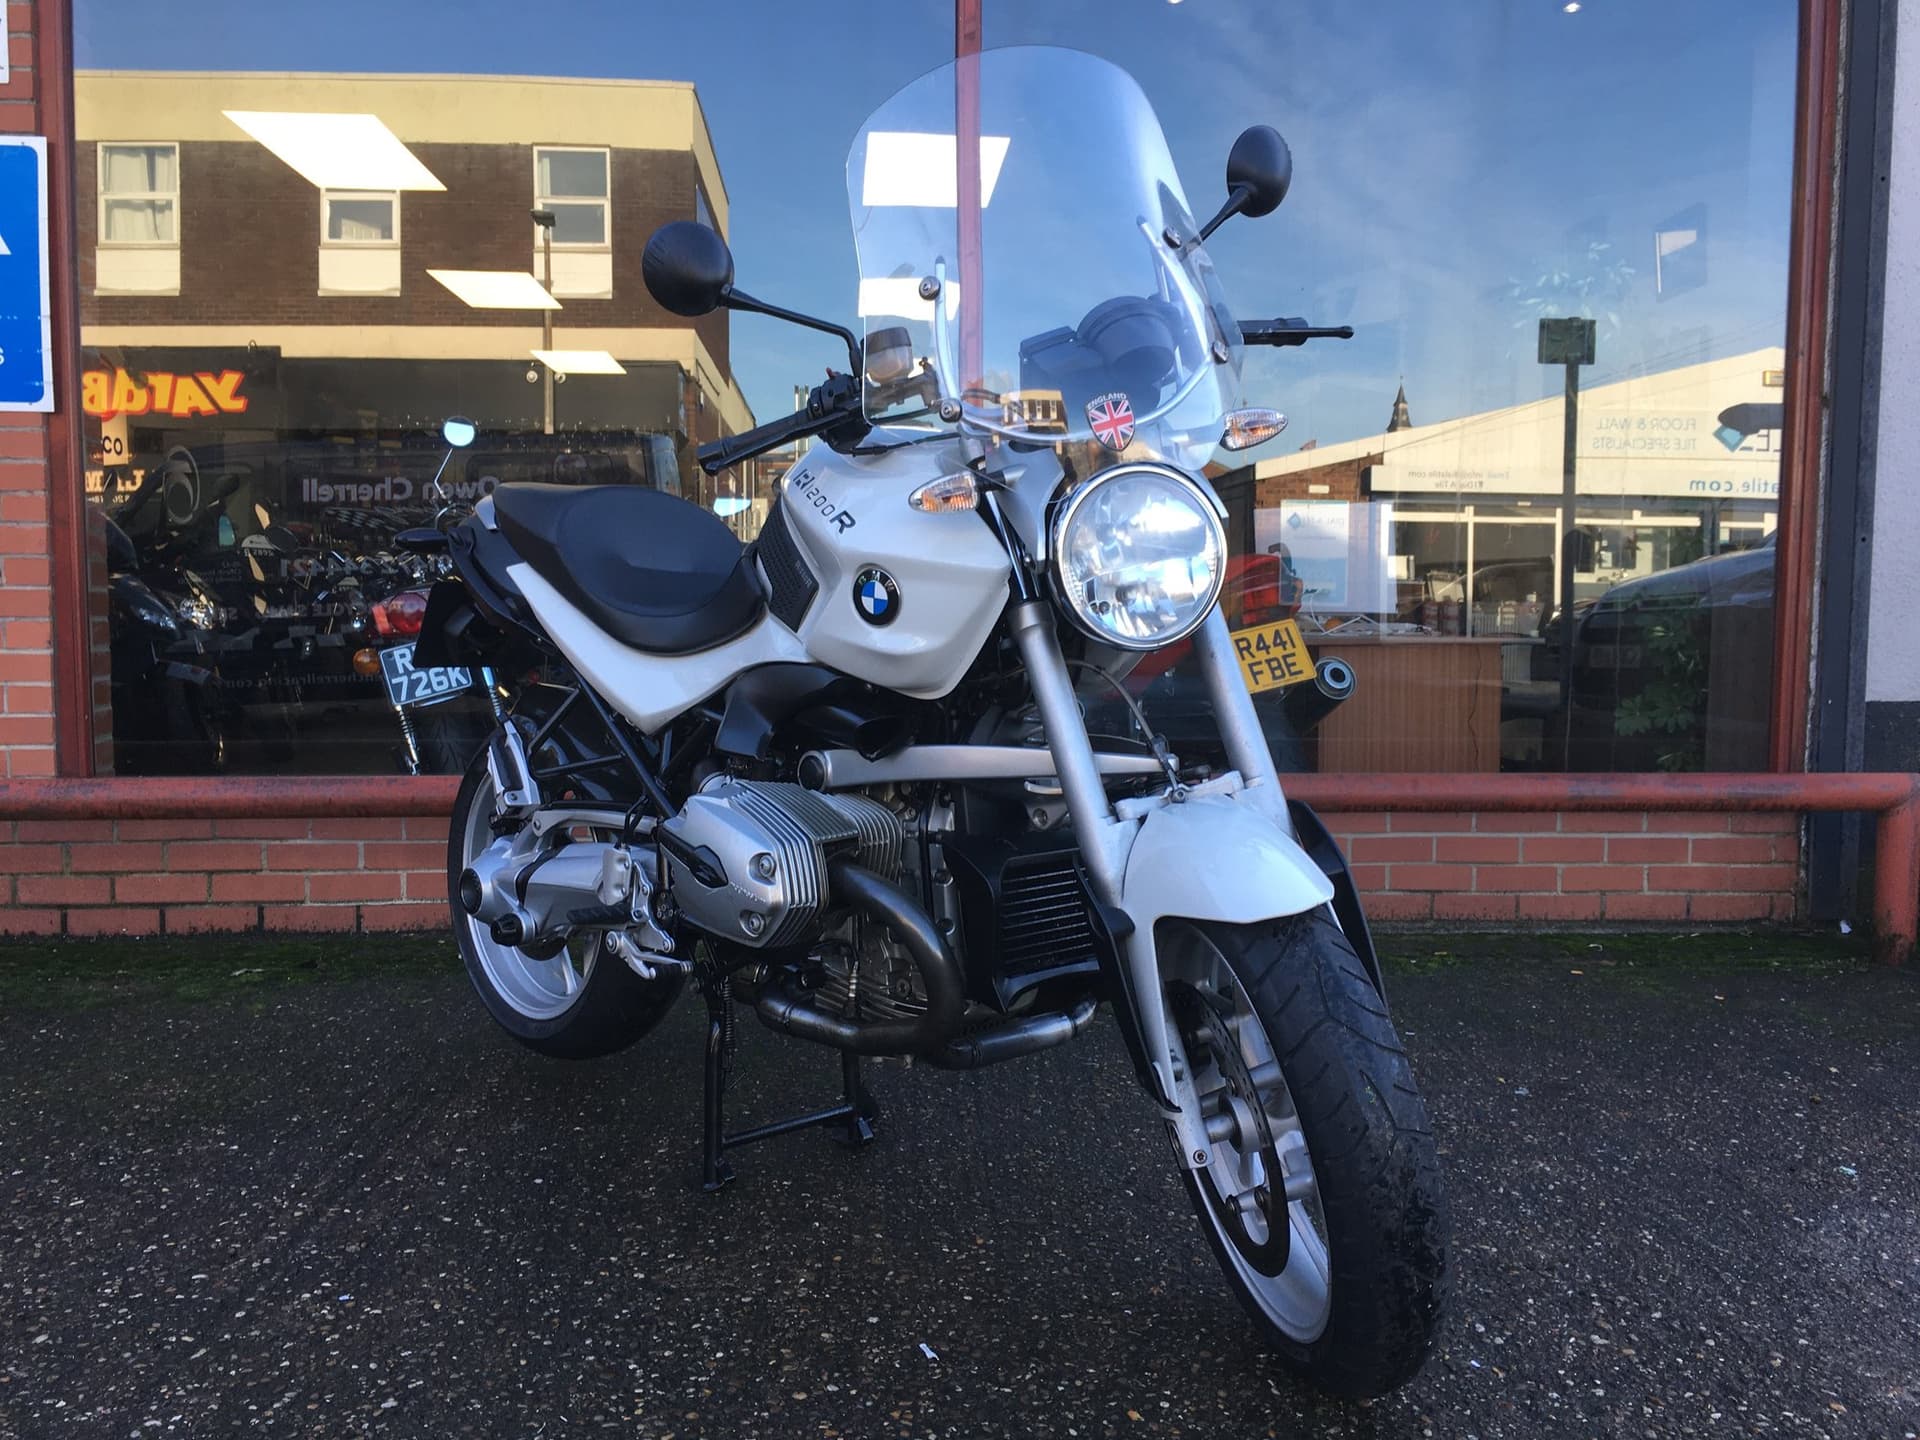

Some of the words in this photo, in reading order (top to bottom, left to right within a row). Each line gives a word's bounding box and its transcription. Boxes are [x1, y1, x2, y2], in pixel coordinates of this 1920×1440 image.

[1086, 392, 1127, 410] ENGLAND
[1234, 626, 1296, 661] R441
[391, 665, 470, 701] 726K
[1247, 652, 1304, 685] FBE
